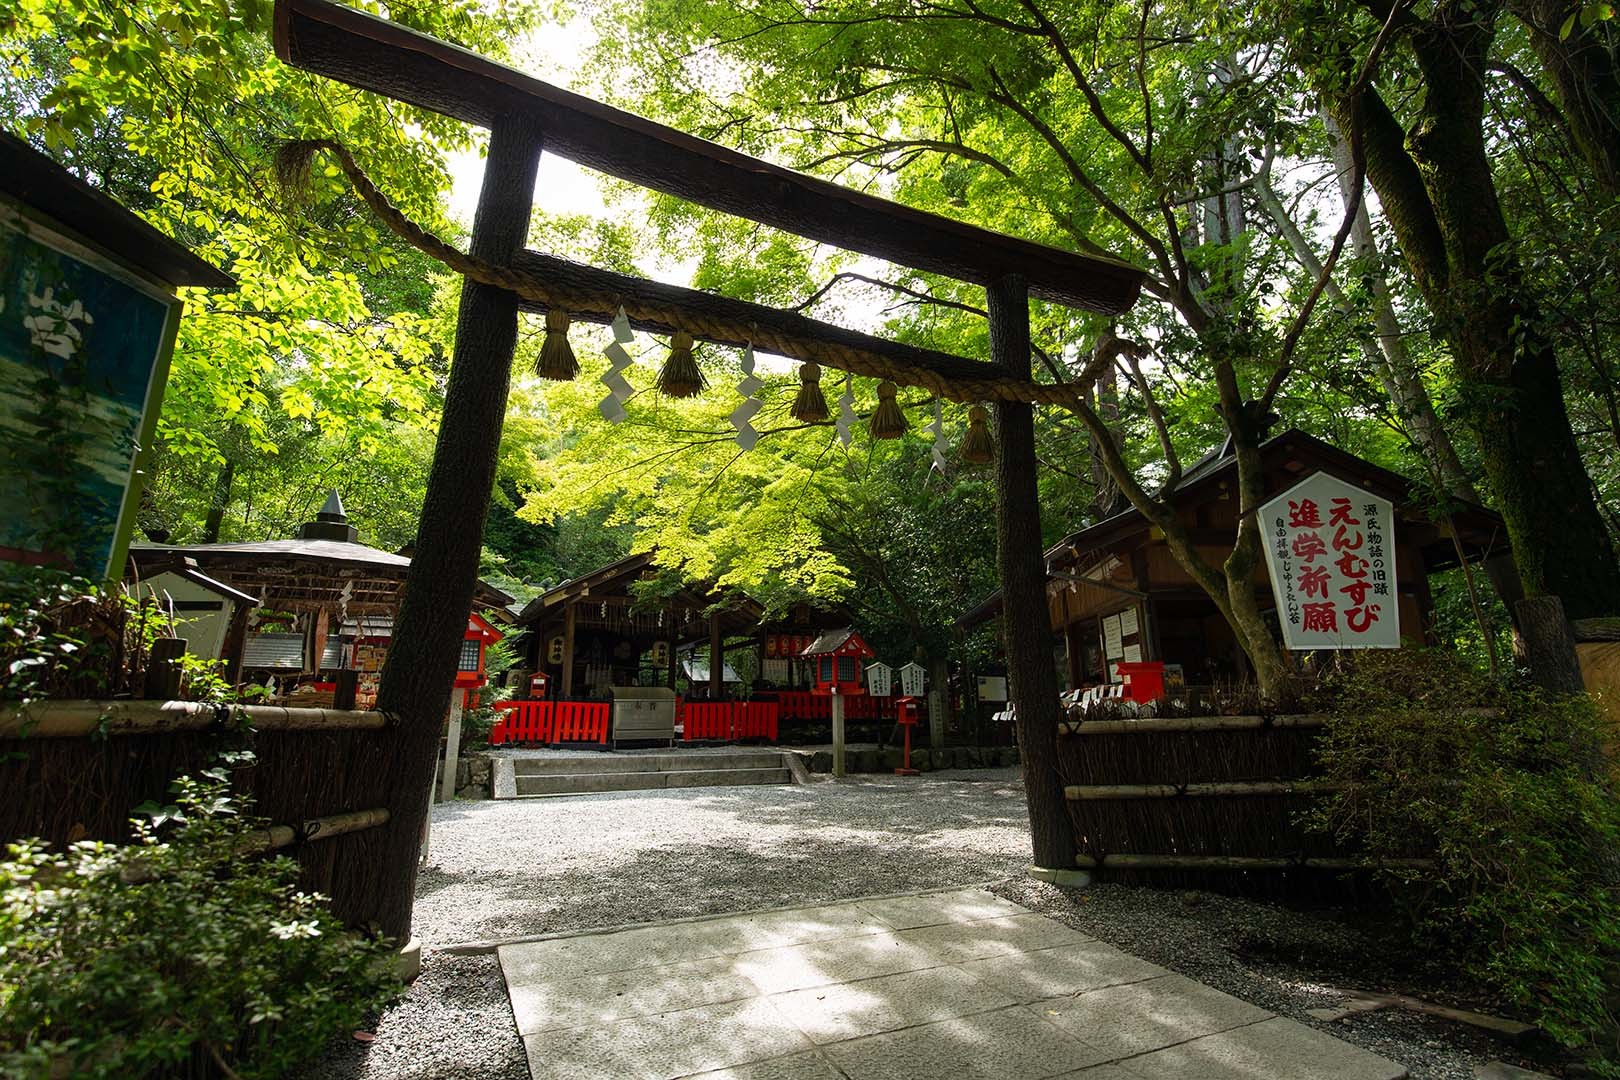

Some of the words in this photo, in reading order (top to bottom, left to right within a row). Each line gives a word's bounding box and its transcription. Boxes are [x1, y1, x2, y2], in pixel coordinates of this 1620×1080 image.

[1288, 498, 1338, 633] 進学祈願
[1329, 497, 1381, 633] えんむすび
